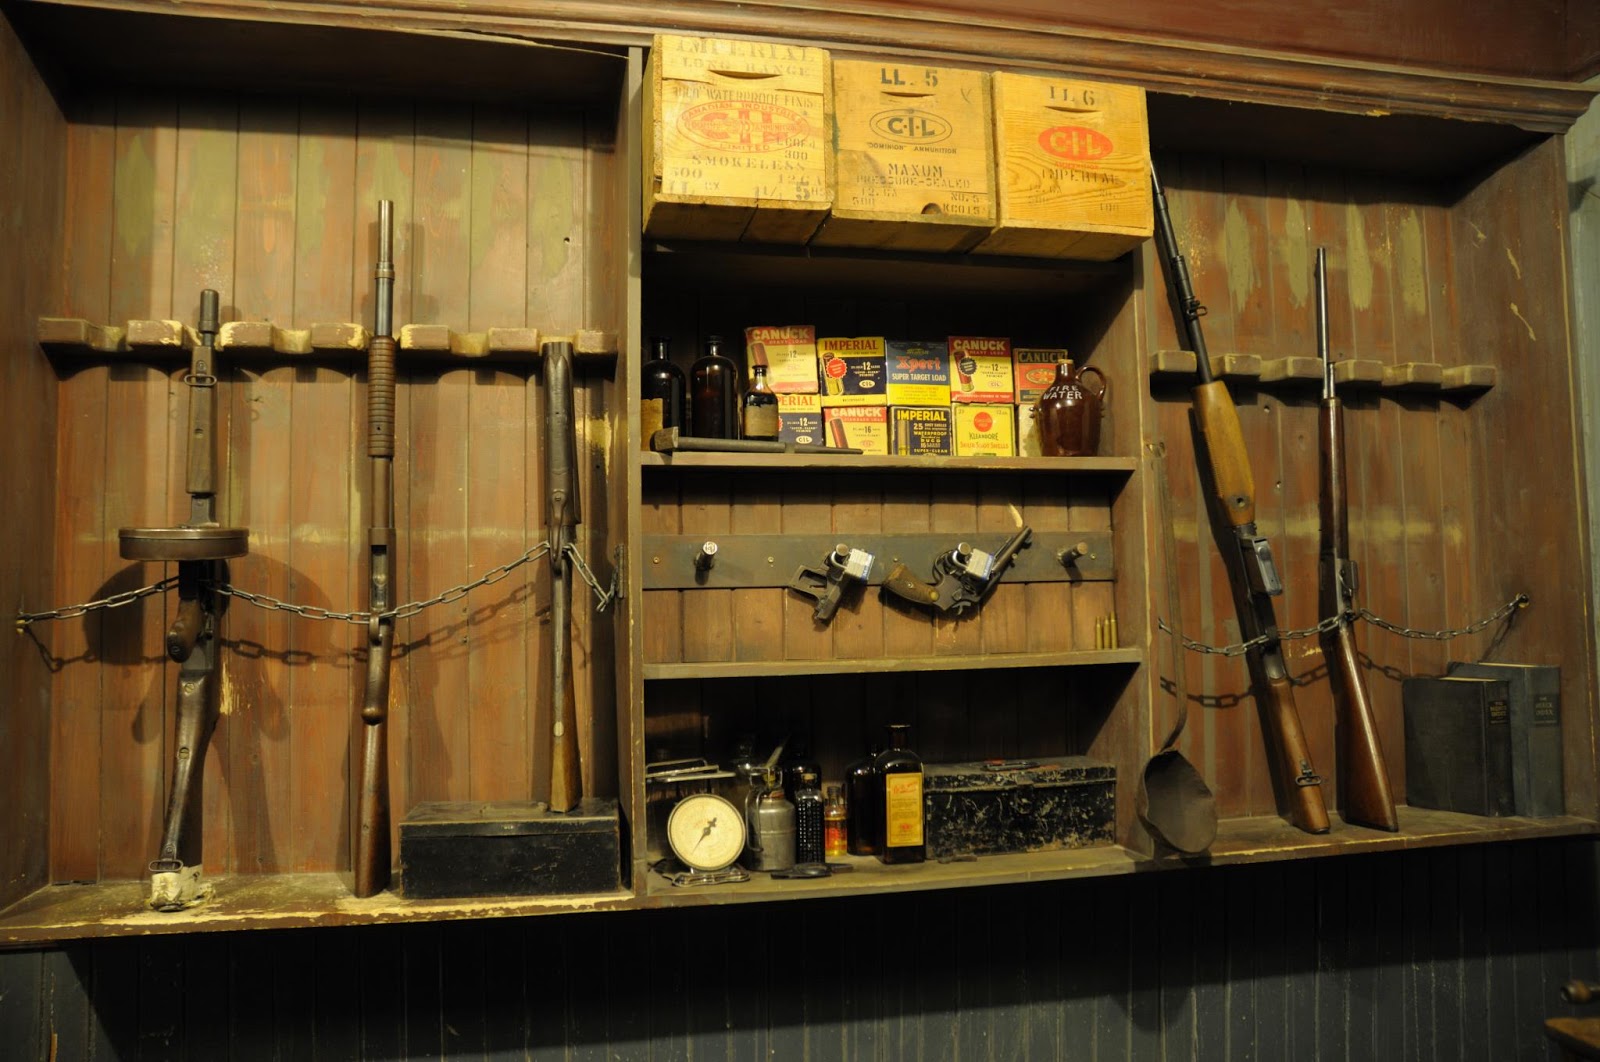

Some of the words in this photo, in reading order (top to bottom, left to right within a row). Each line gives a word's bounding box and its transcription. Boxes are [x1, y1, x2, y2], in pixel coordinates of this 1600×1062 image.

[925, 69, 939, 87] 5
[719, 142, 770, 152] LIMITED
[913, 145, 957, 155] AMMUNITION
[691, 154, 806, 172] SMOKELESS
[887, 162, 944, 178] MAXUM
[753, 329, 809, 340] CANUCK
[824, 340, 879, 351] IMPERIAL
[953, 340, 1006, 351] CANUCK
[788, 350, 798, 359] 12
[862, 361, 872, 371] 12
[896, 356, 941, 373] Xpert
[991, 363, 999, 372] 12
[891, 372, 910, 381] SUPER
[910, 373, 931, 382] TARGET
[931, 374, 947, 382] LOAD
[1049, 384, 1080, 393] FIRE
[1043, 390, 1083, 400] WATER
[831, 407, 882, 418] CANUCK
[897, 410, 947, 421] IMPERIAL
[799, 417, 808, 427] 12
[913, 422, 924, 431] 25
[864, 425, 872, 434] 16
